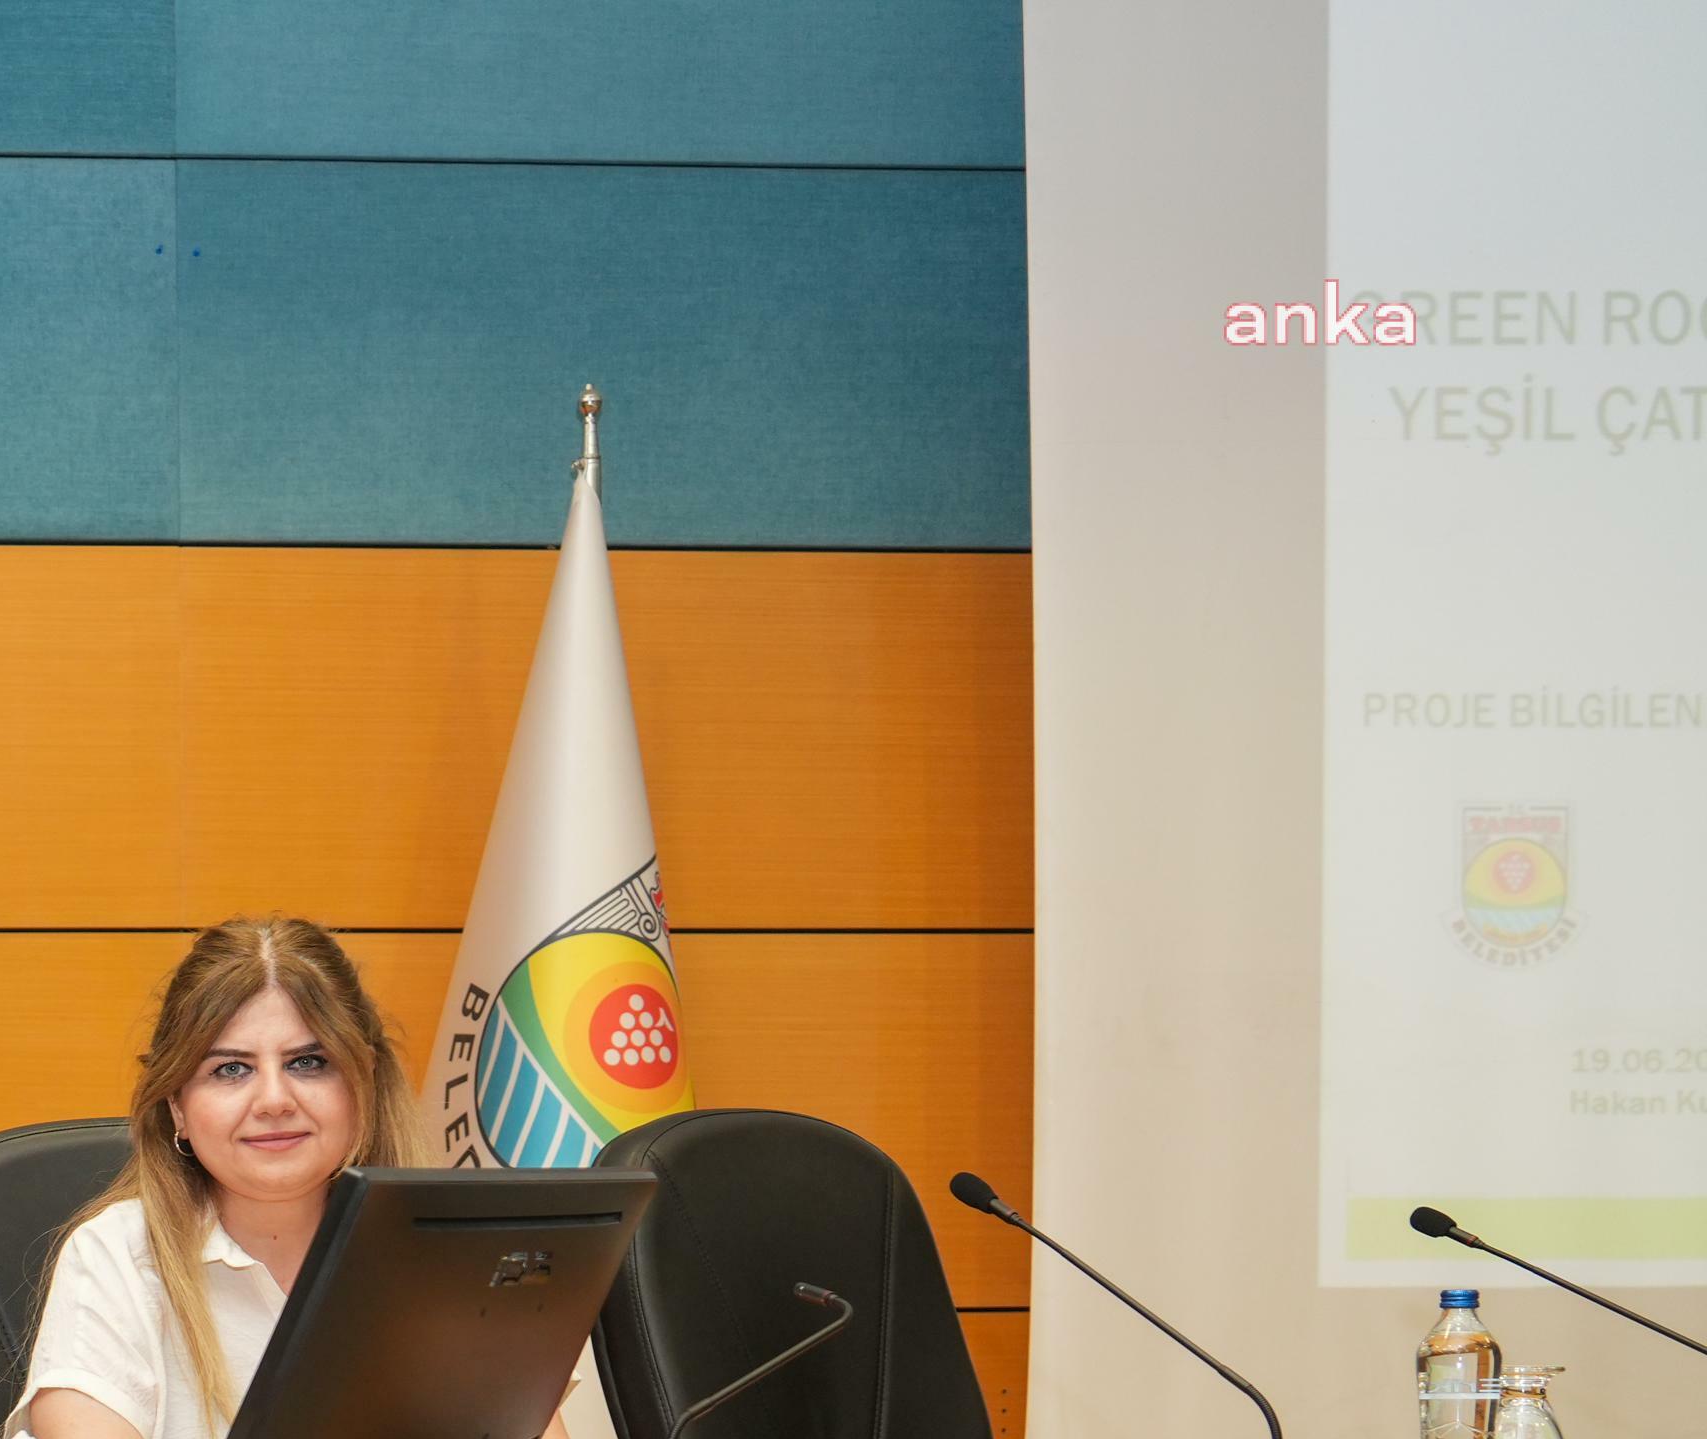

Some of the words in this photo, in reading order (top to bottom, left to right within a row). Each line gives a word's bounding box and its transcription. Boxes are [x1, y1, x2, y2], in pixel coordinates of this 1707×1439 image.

[1601, 289, 1707, 346] RO
[1389, 372, 1576, 456] YEŞİL
[1360, 691, 1497, 729] PROJE
[1568, 1088, 1667, 1116] Hakan
